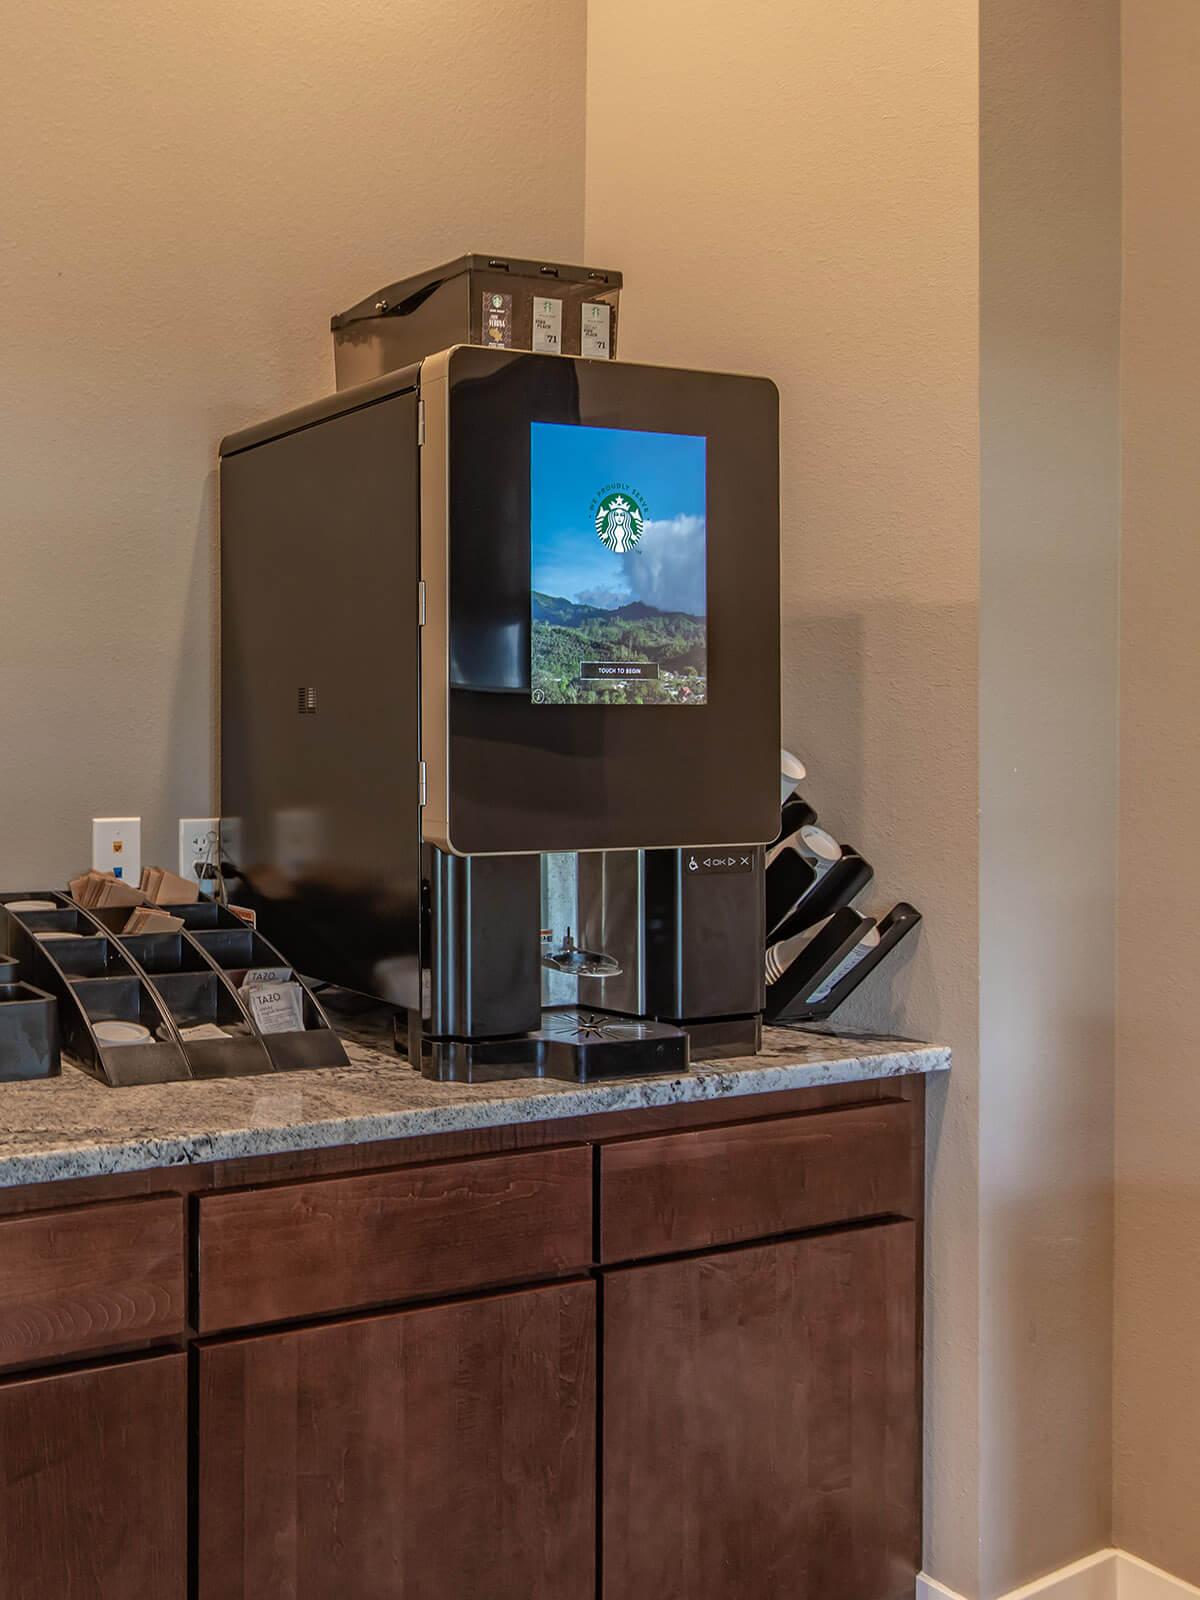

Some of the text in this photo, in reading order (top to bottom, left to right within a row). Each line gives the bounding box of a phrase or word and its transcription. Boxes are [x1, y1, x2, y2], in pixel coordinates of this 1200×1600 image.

[597, 482, 630, 496] PROUDLY
[632, 489, 649, 512] SERVE
[253, 971, 276, 981] TAZO
[256, 992, 281, 1005] TAZO
